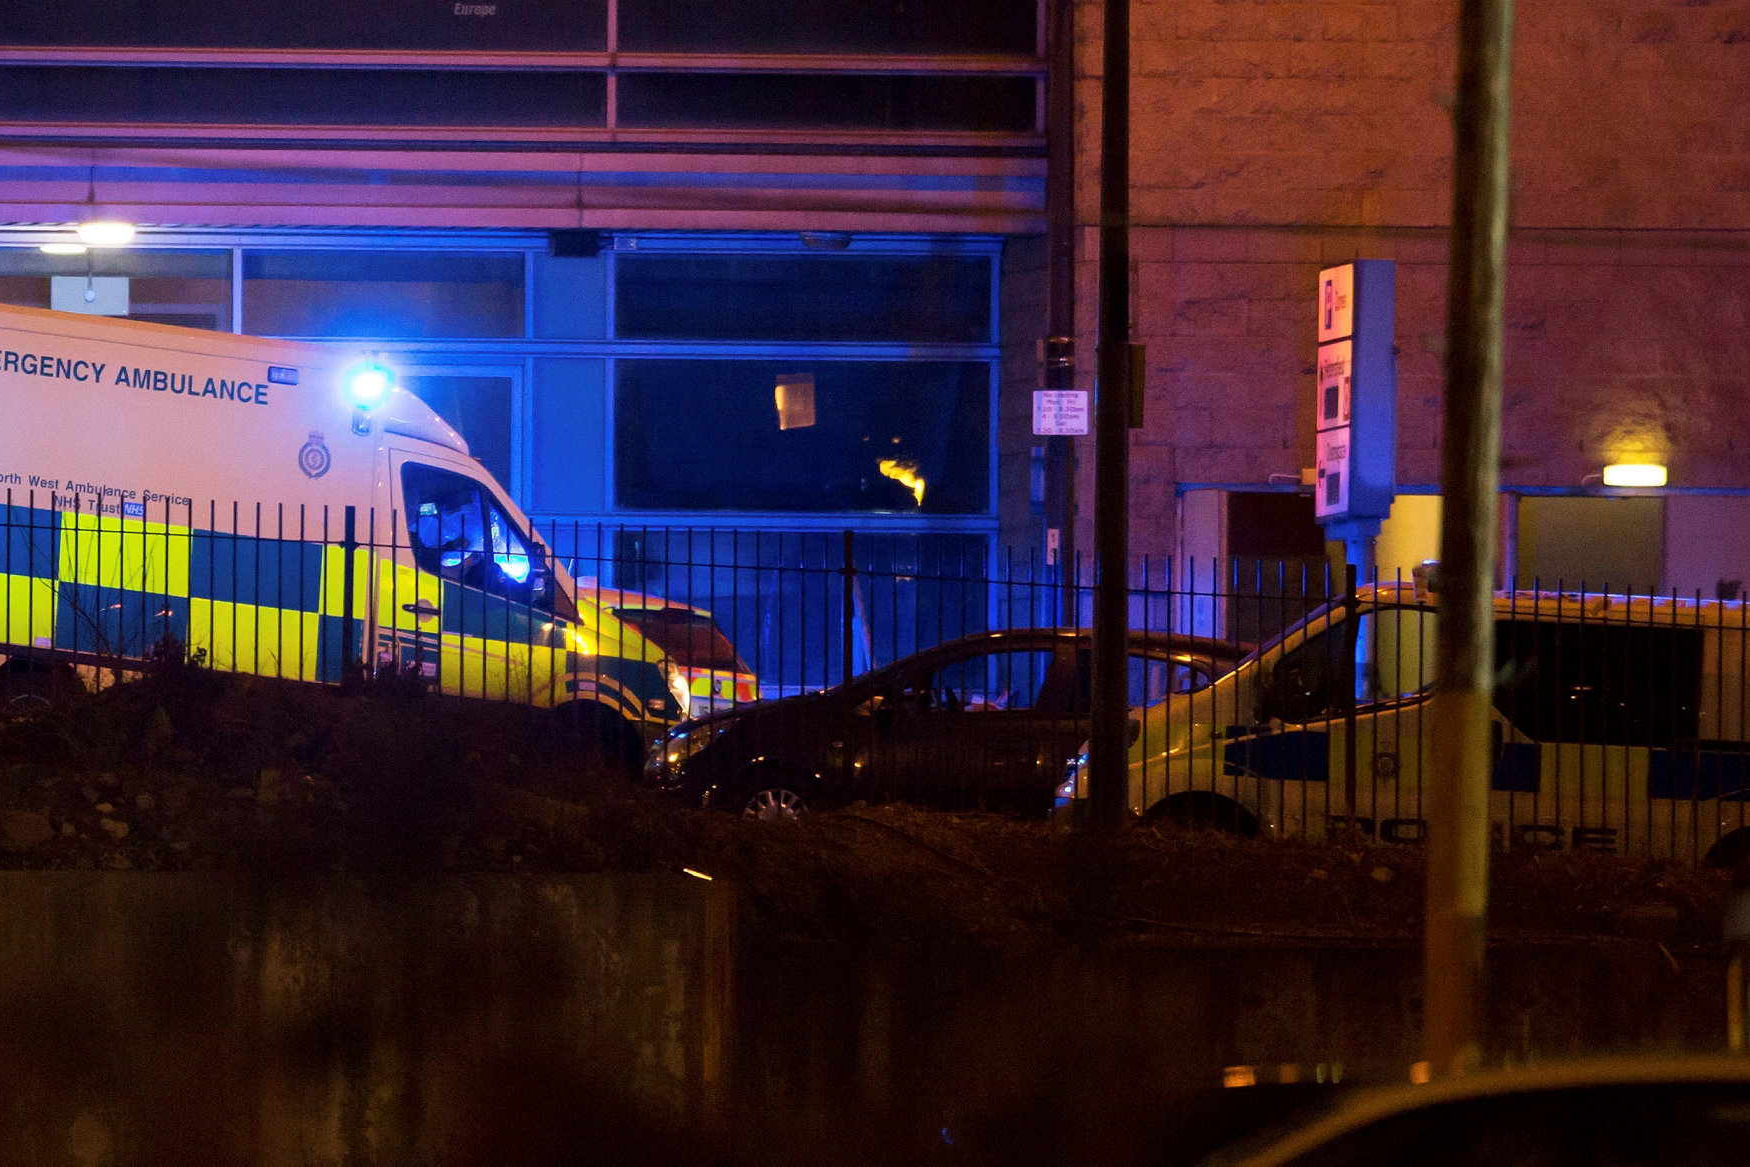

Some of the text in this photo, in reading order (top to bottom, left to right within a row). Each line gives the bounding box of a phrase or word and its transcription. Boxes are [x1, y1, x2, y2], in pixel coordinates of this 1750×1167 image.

[453, 1, 498, 18] Europe
[114, 365, 270, 406] AMBULANCE
[29, 474, 60, 490] West
[65, 479, 137, 500] Ambulance
[143, 489, 190, 507] Service
[53, 494, 82, 509] NHS
[1327, 814, 1618, 853] POCE
